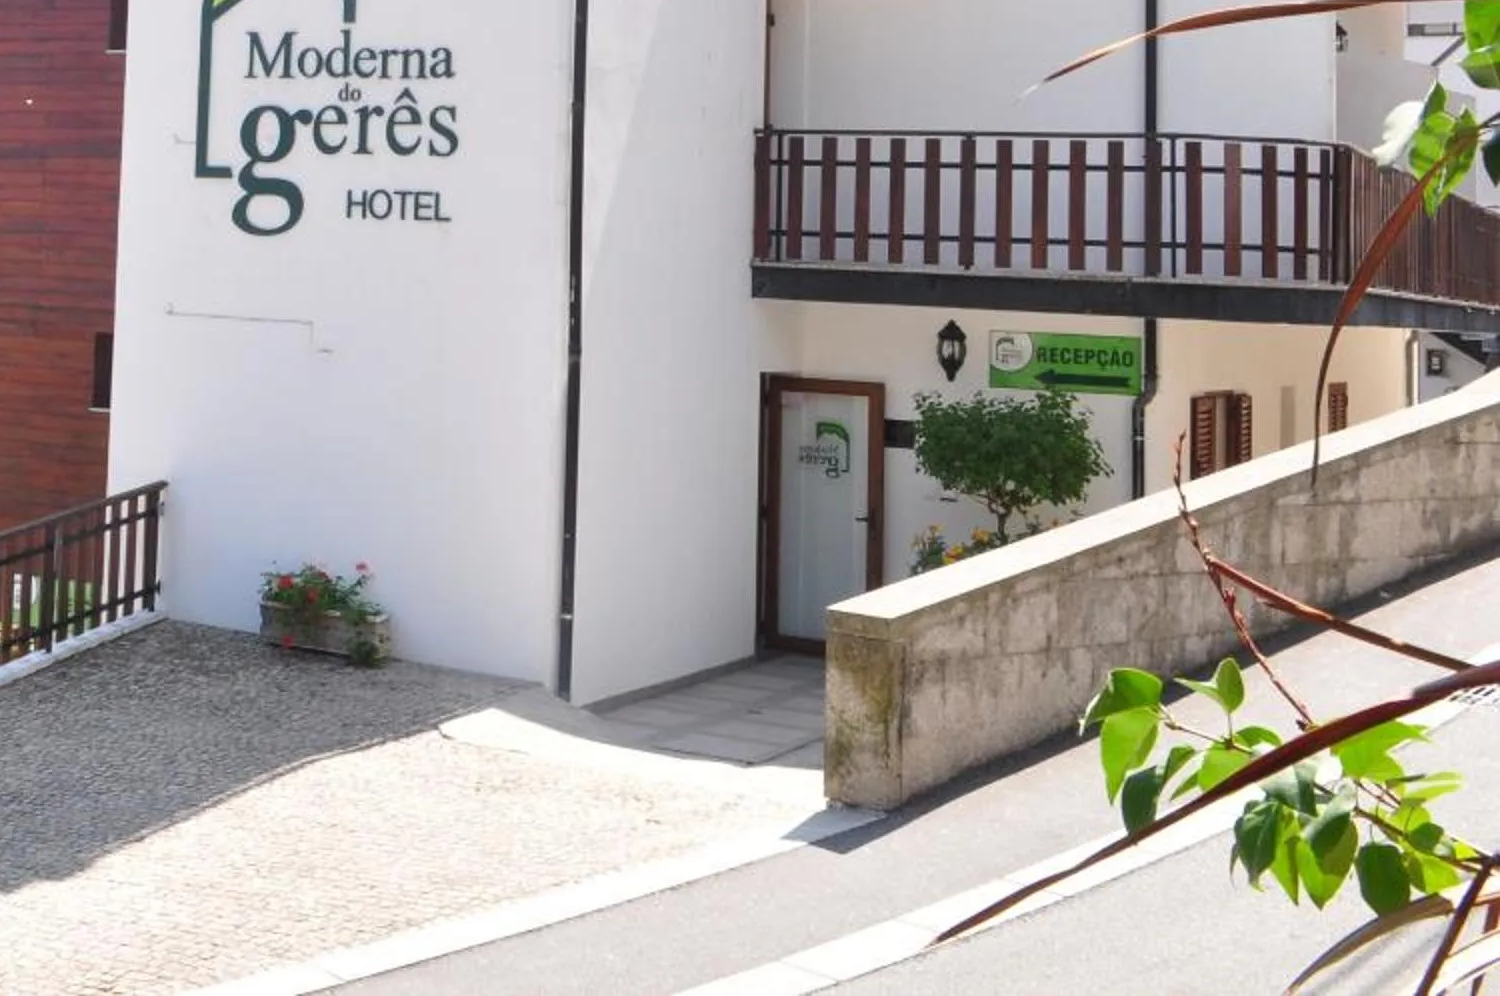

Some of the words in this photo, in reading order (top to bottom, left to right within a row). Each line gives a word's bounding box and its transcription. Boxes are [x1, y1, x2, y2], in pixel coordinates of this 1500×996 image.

[244, 29, 455, 79] Moderna
[338, 82, 361, 102] do
[231, 87, 459, 236] gerês
[346, 189, 452, 222] HOTEL
[1036, 345, 1134, 370] RECEPÇÃO
